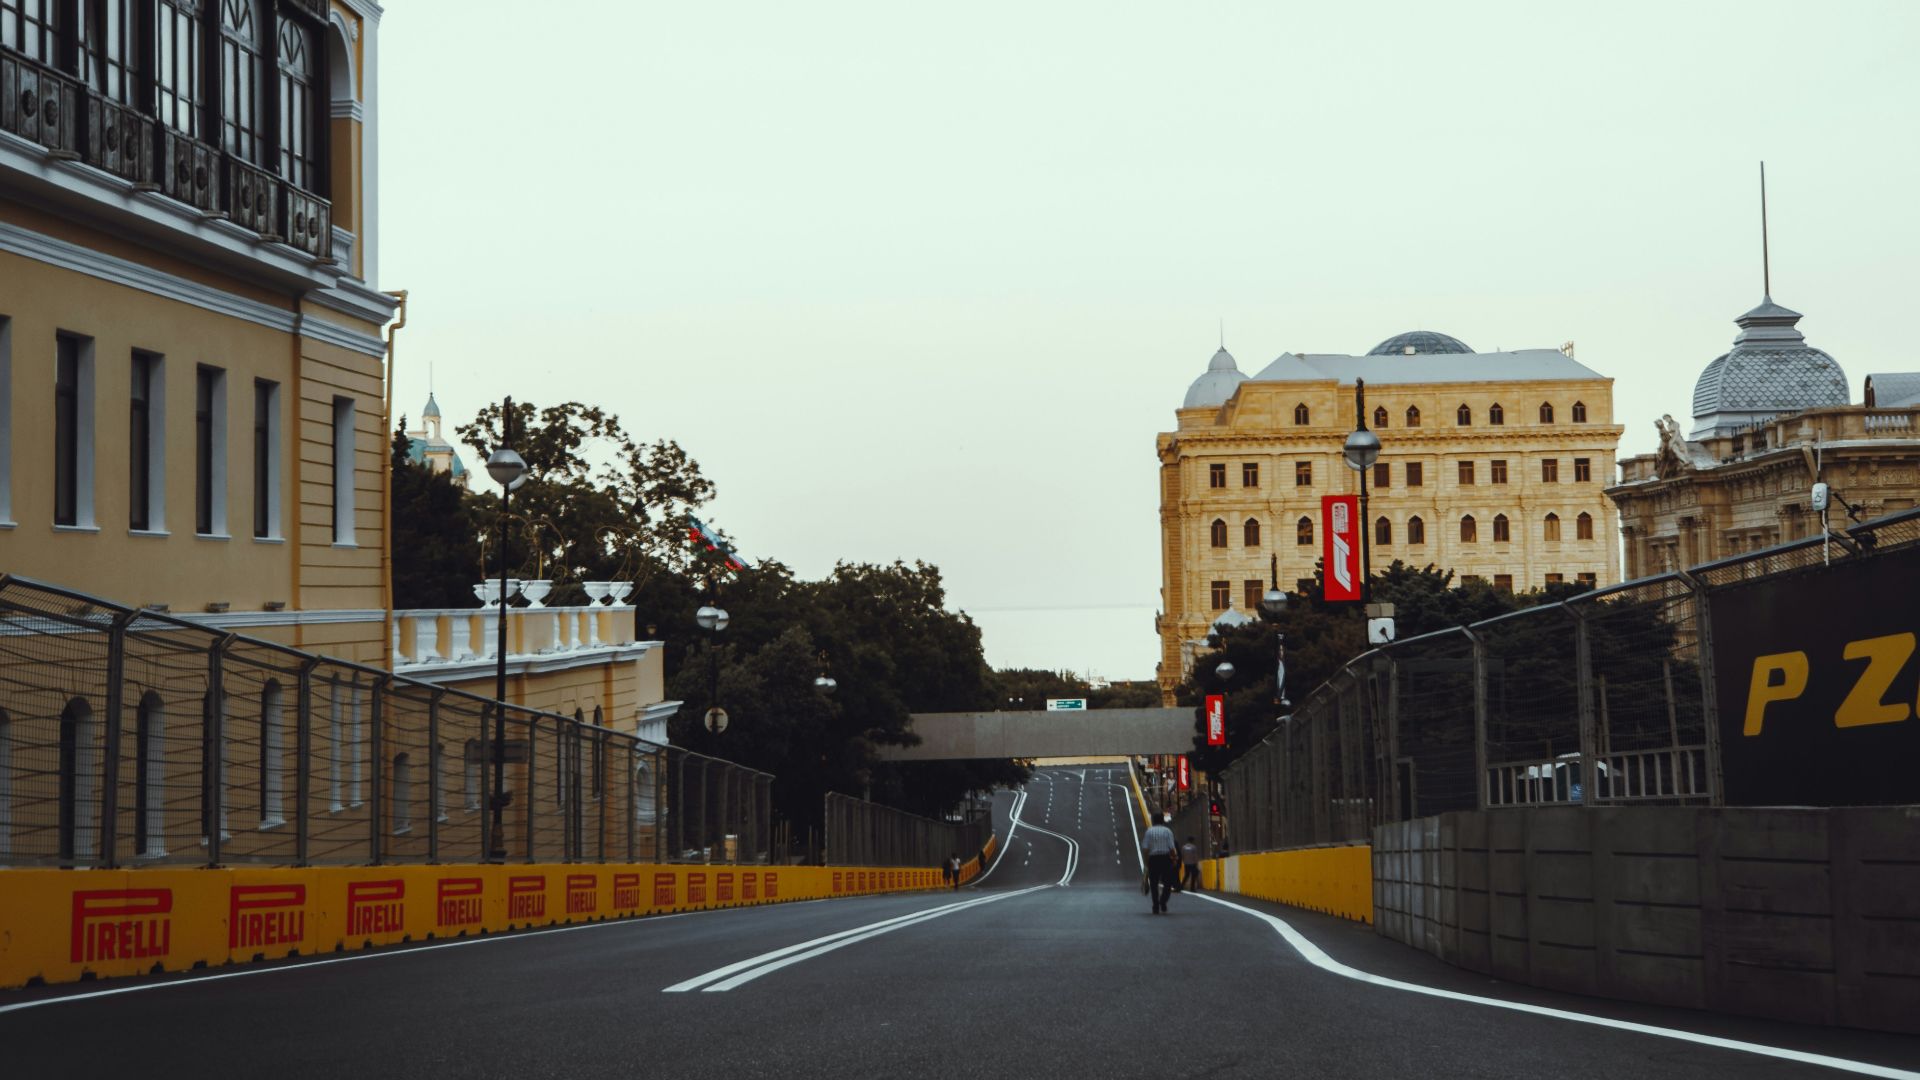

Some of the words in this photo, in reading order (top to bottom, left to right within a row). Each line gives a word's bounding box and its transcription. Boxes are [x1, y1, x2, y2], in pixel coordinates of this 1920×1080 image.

[1834, 632, 1920, 729] Z
[228, 884, 306, 949] PIRELLI
[346, 879, 405, 936] PIRELLI
[437, 878, 483, 927] PIRELLI
[508, 875, 546, 919] PIRELLI
[567, 874, 597, 914] PIRELLI
[614, 874, 640, 909] PIRELLI
[71, 888, 173, 963] PIRELLI
